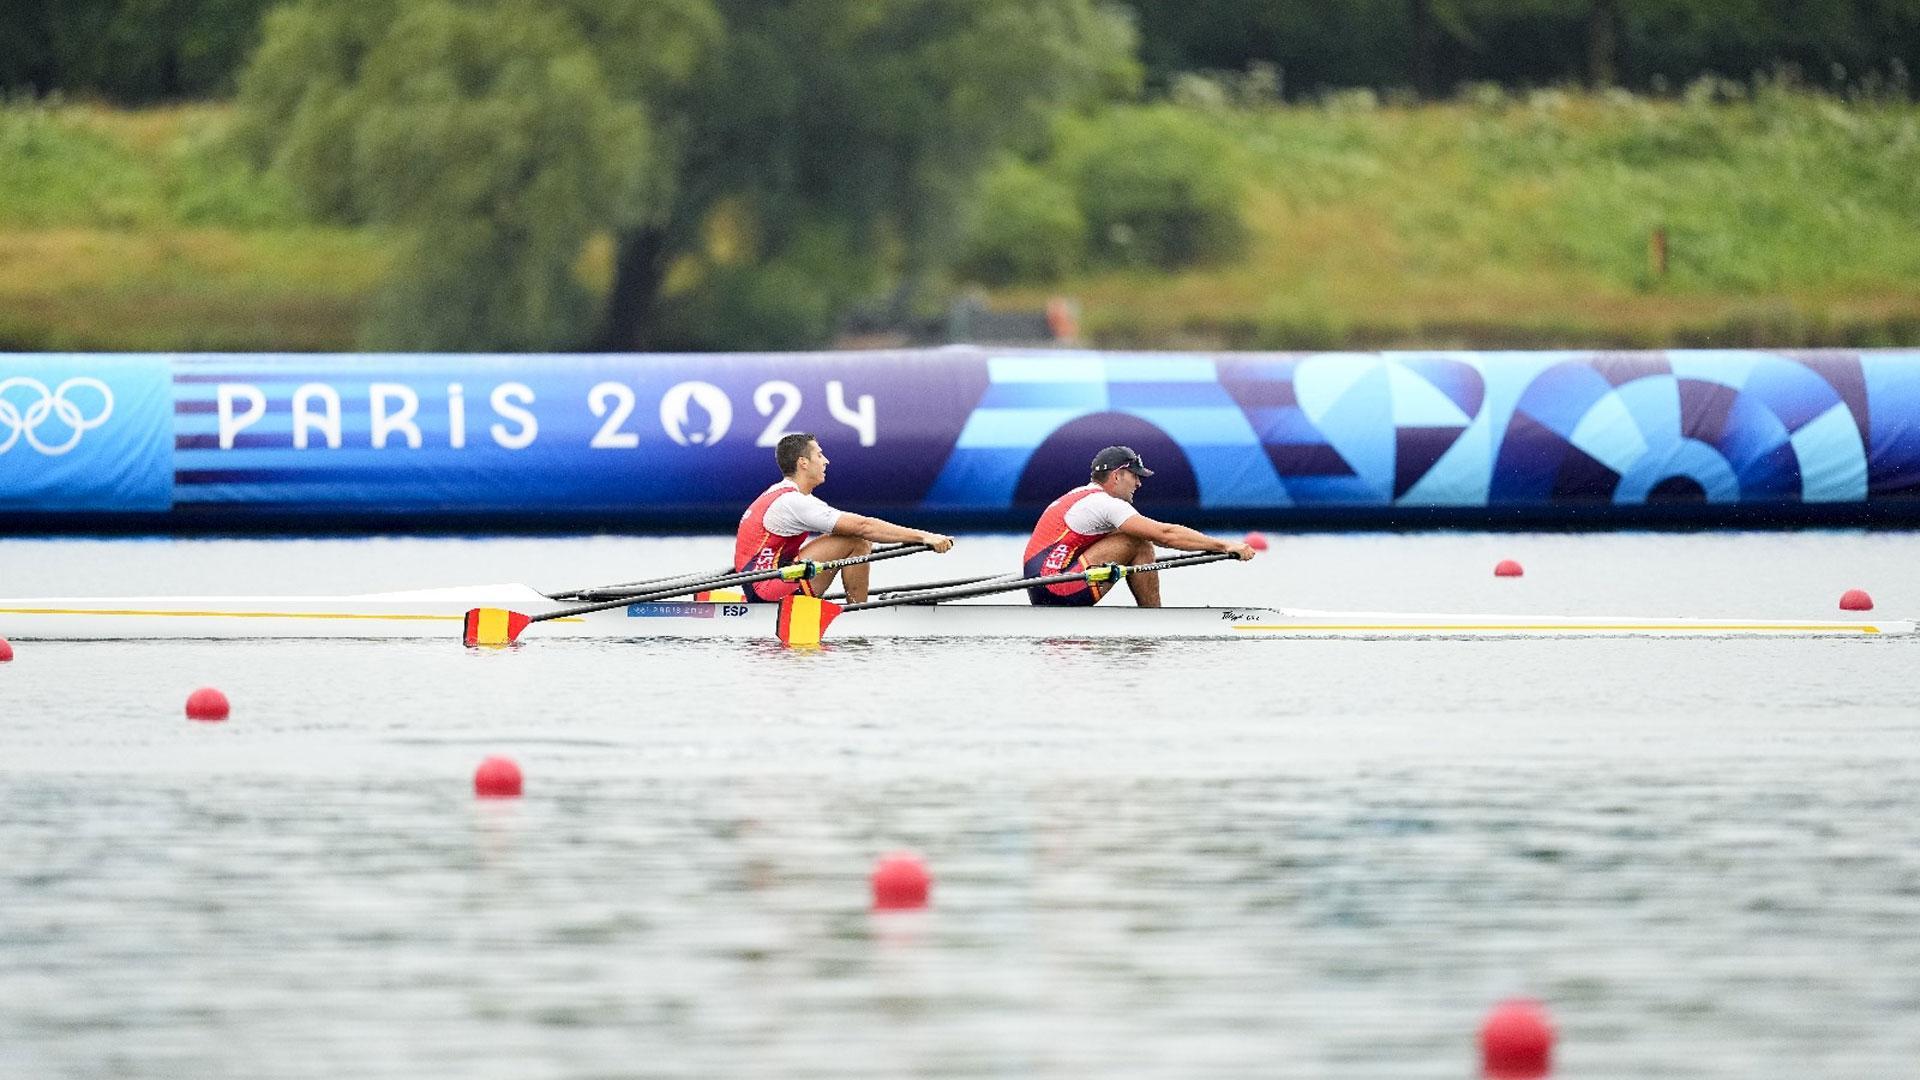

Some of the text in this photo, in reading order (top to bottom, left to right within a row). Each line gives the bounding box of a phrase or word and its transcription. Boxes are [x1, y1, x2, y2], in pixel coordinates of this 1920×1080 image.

[587, 380, 877, 449] 2024
[756, 547, 775, 571] ESP
[1046, 544, 1069, 570] ESP
[722, 605, 748, 617] ESP
